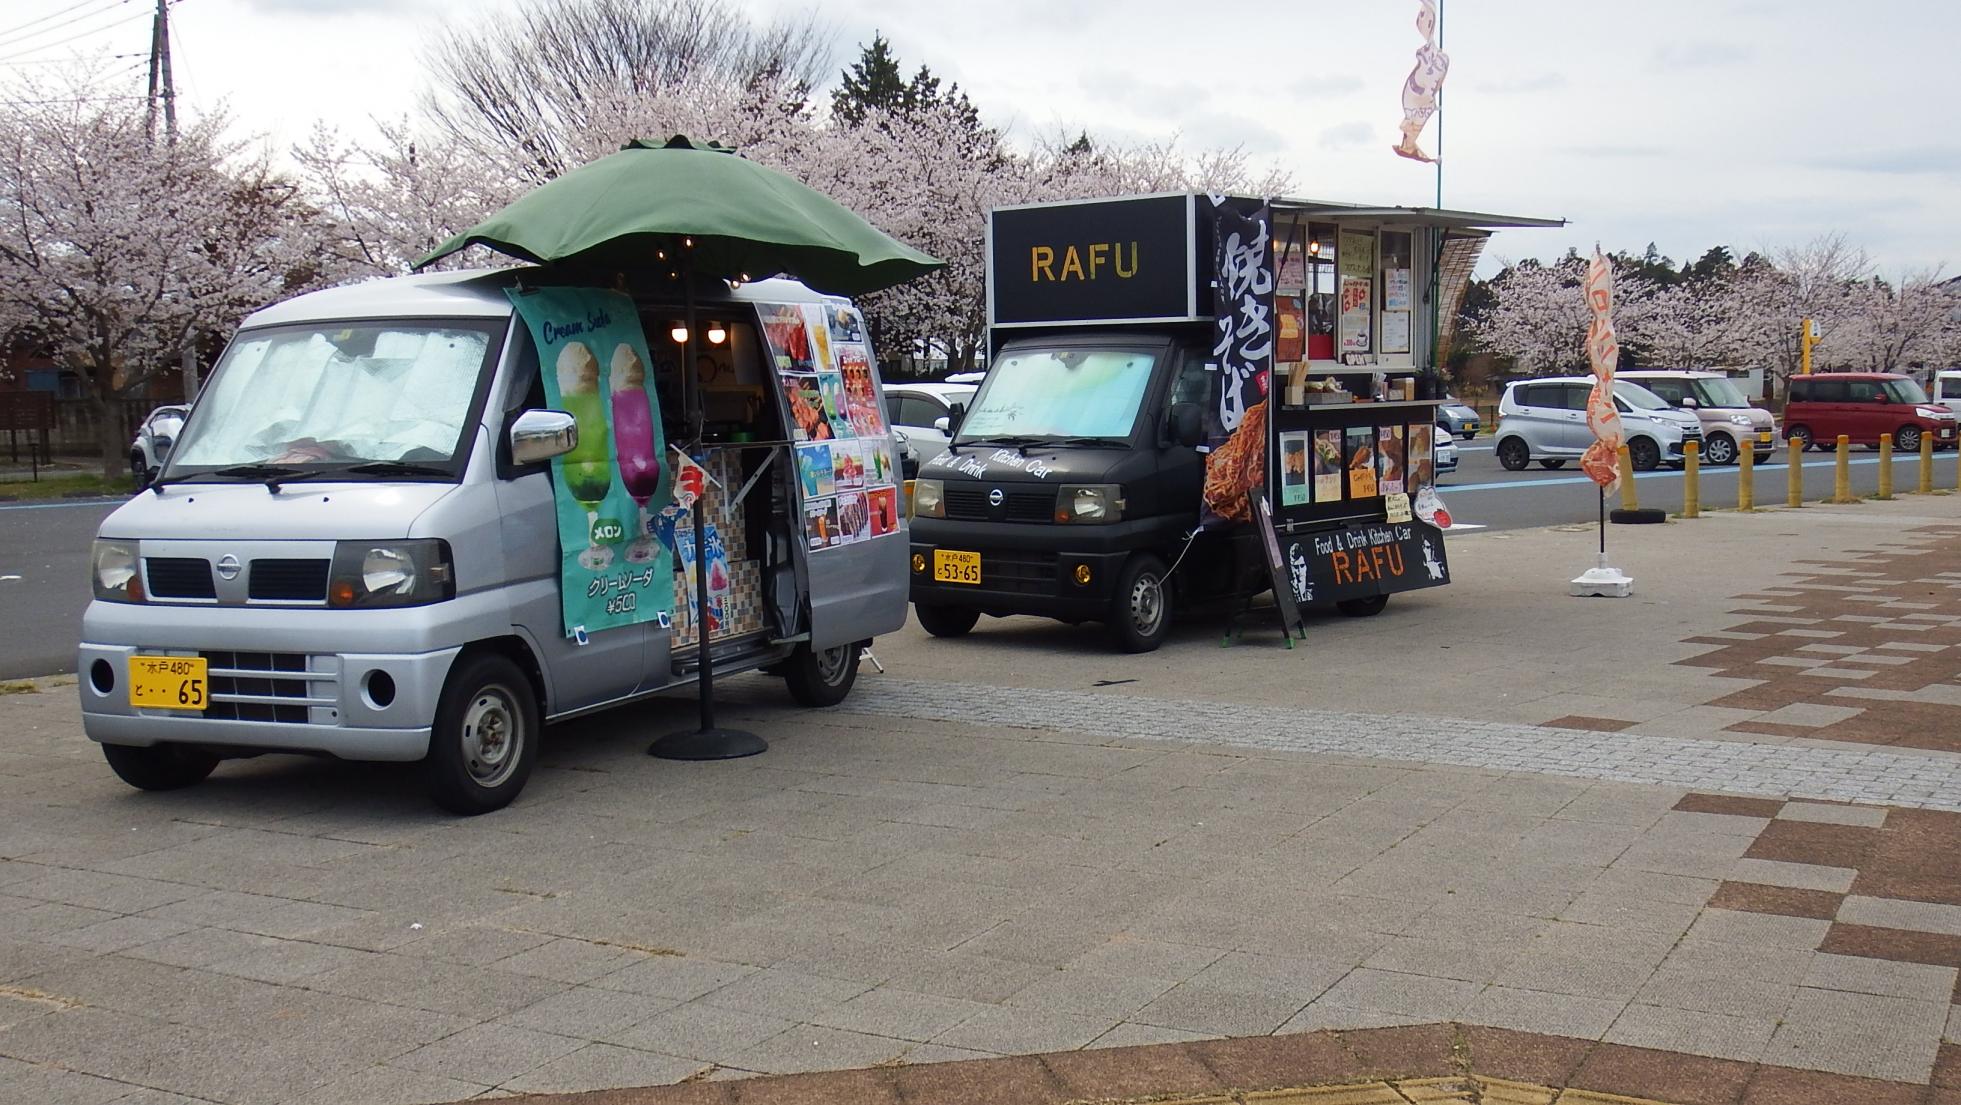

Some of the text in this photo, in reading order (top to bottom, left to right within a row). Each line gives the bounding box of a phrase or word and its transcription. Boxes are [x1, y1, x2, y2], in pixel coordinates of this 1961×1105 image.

[1031, 241, 1138, 282] RAFU
[542, 321, 584, 345] Cream
[1213, 218, 1272, 433] 焼きそば
[959, 458, 988, 480] Drink
[989, 448, 1053, 479] Kitchen Car
[594, 525, 622, 540] メロン
[1314, 525, 1412, 555] Food & Drink Kitchen Car
[944, 563, 978, 581] 53-65
[1331, 543, 1405, 585] RAFU
[588, 567, 654, 597] クリームソーダ
[136, 684, 143, 696] と
[178, 680, 202, 705] 65
